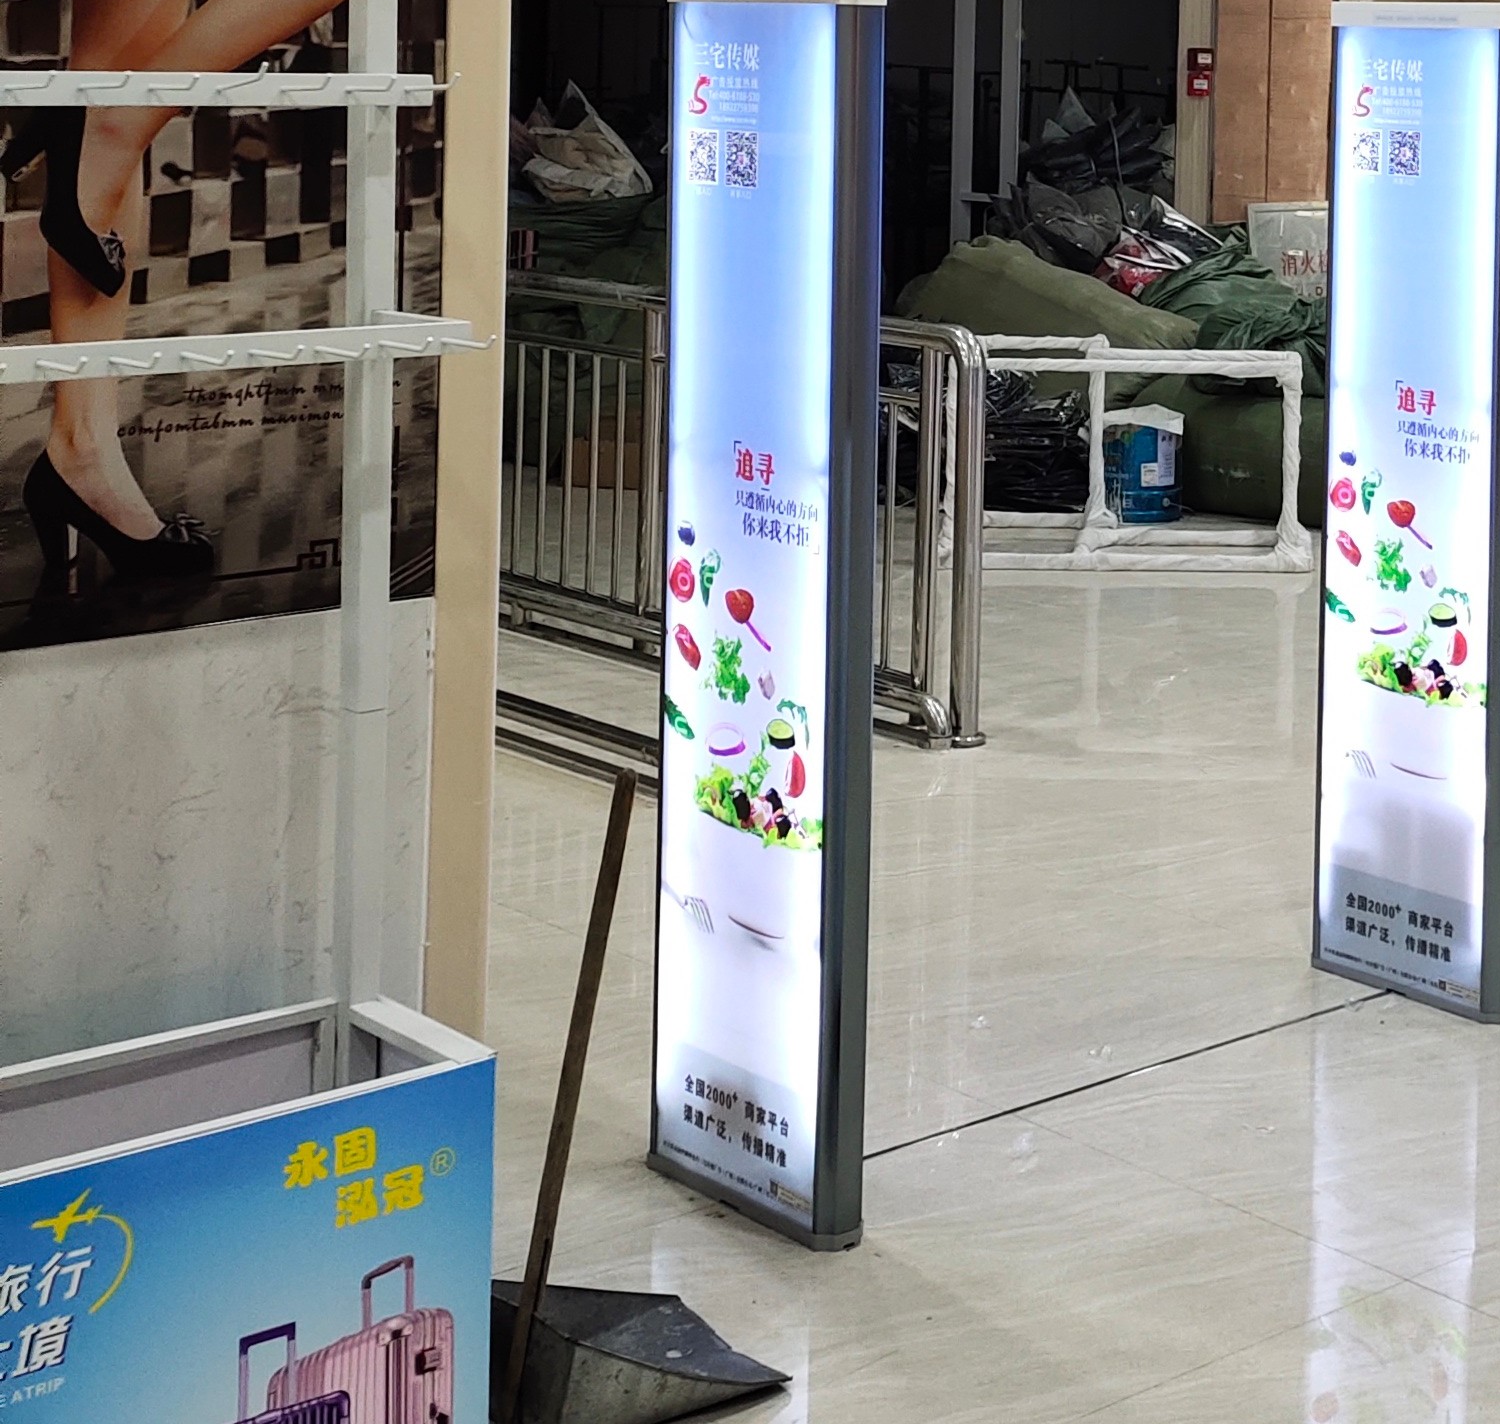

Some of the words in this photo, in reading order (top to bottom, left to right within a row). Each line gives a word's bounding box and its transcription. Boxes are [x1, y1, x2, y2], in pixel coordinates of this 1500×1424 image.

[693, 41, 760, 72] 三宅传媒
[283, 1126, 378, 1190] 永固
[335, 1164, 425, 1229] 泓冠
[0, 1245, 94, 1317] 旅行
